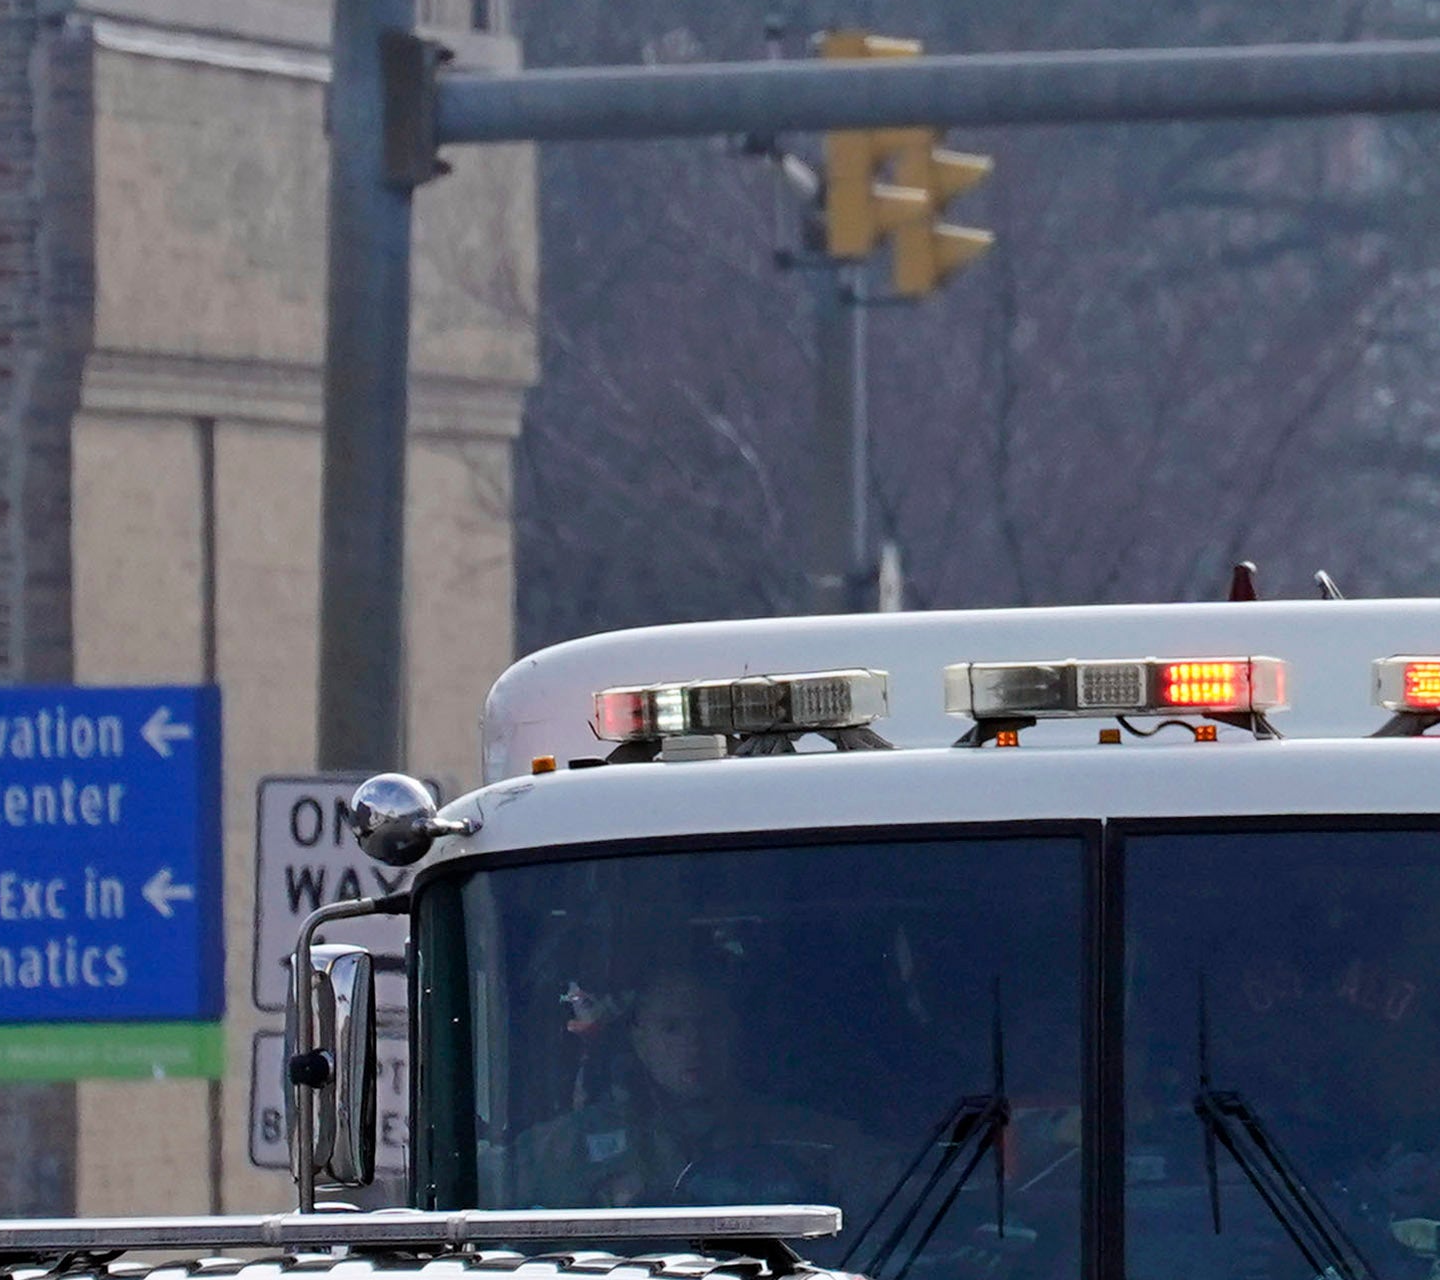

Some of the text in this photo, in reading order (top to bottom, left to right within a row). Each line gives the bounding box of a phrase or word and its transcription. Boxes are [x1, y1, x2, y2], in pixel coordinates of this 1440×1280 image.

[291, 796, 350, 847] ON
[0, 871, 65, 920] Exc
[84, 866, 124, 920] in
